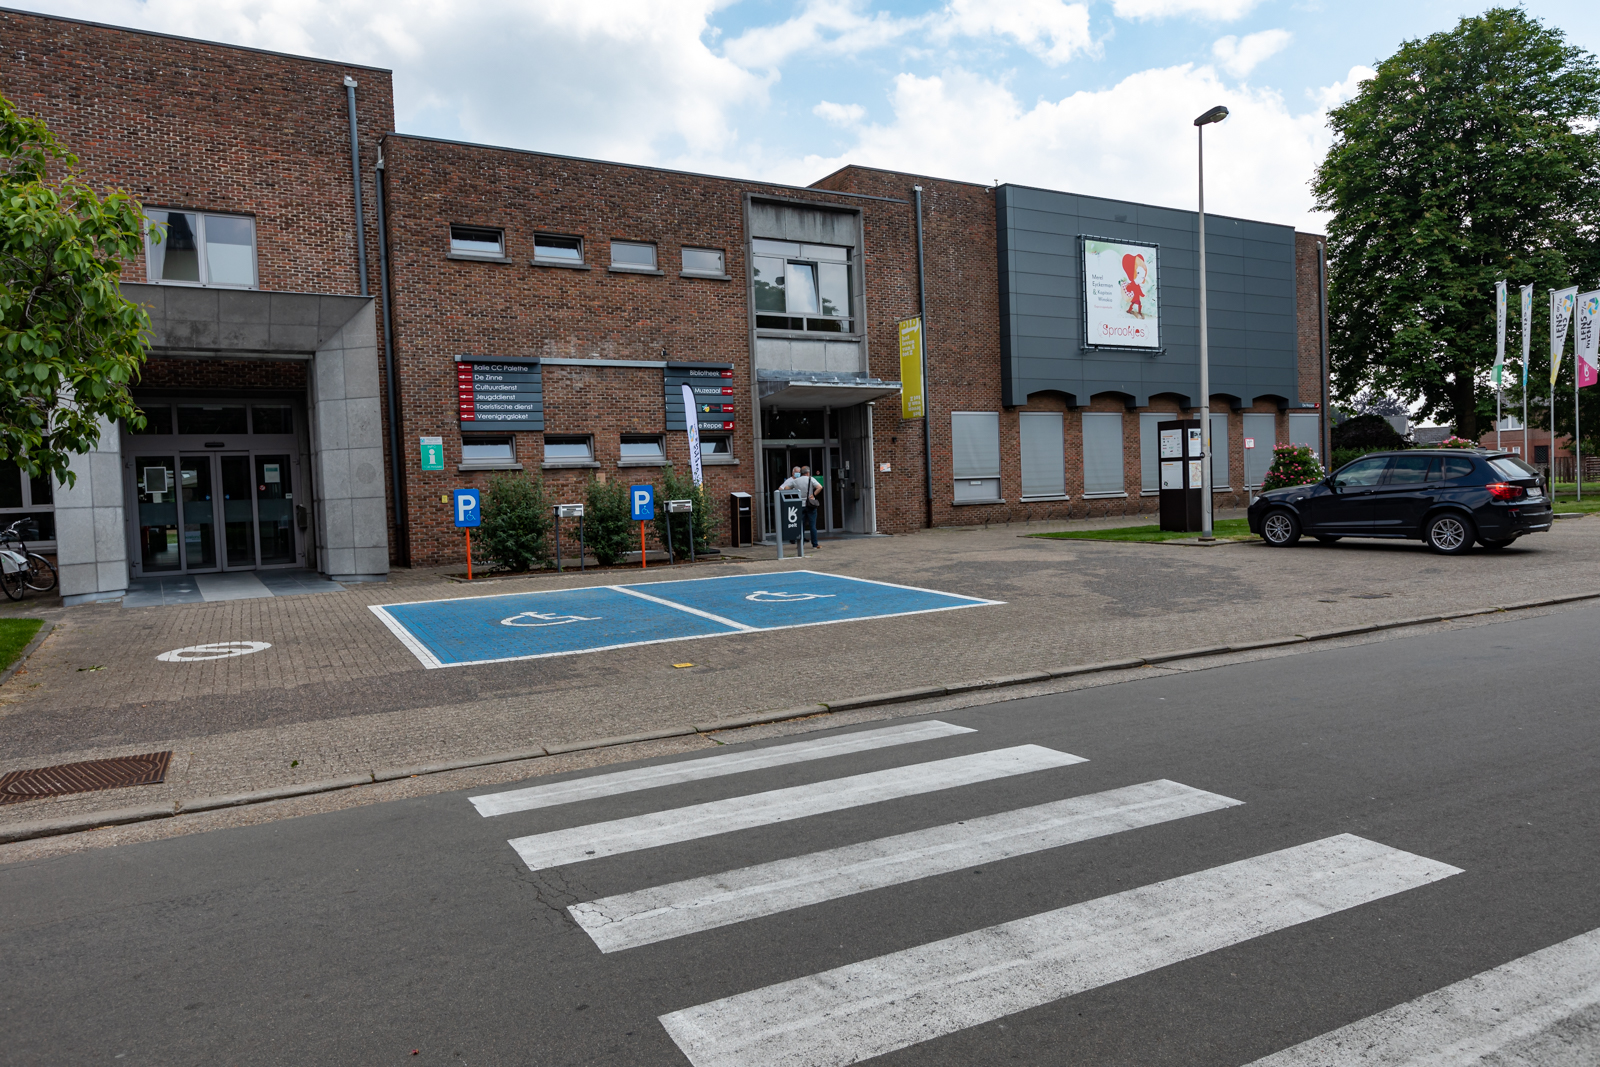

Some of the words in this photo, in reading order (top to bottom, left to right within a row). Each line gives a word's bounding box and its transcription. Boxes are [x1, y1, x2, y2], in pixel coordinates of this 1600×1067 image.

[1102, 323, 1146, 339] Sprookjes
[458, 495, 476, 521] P
[634, 491, 650, 515] P
